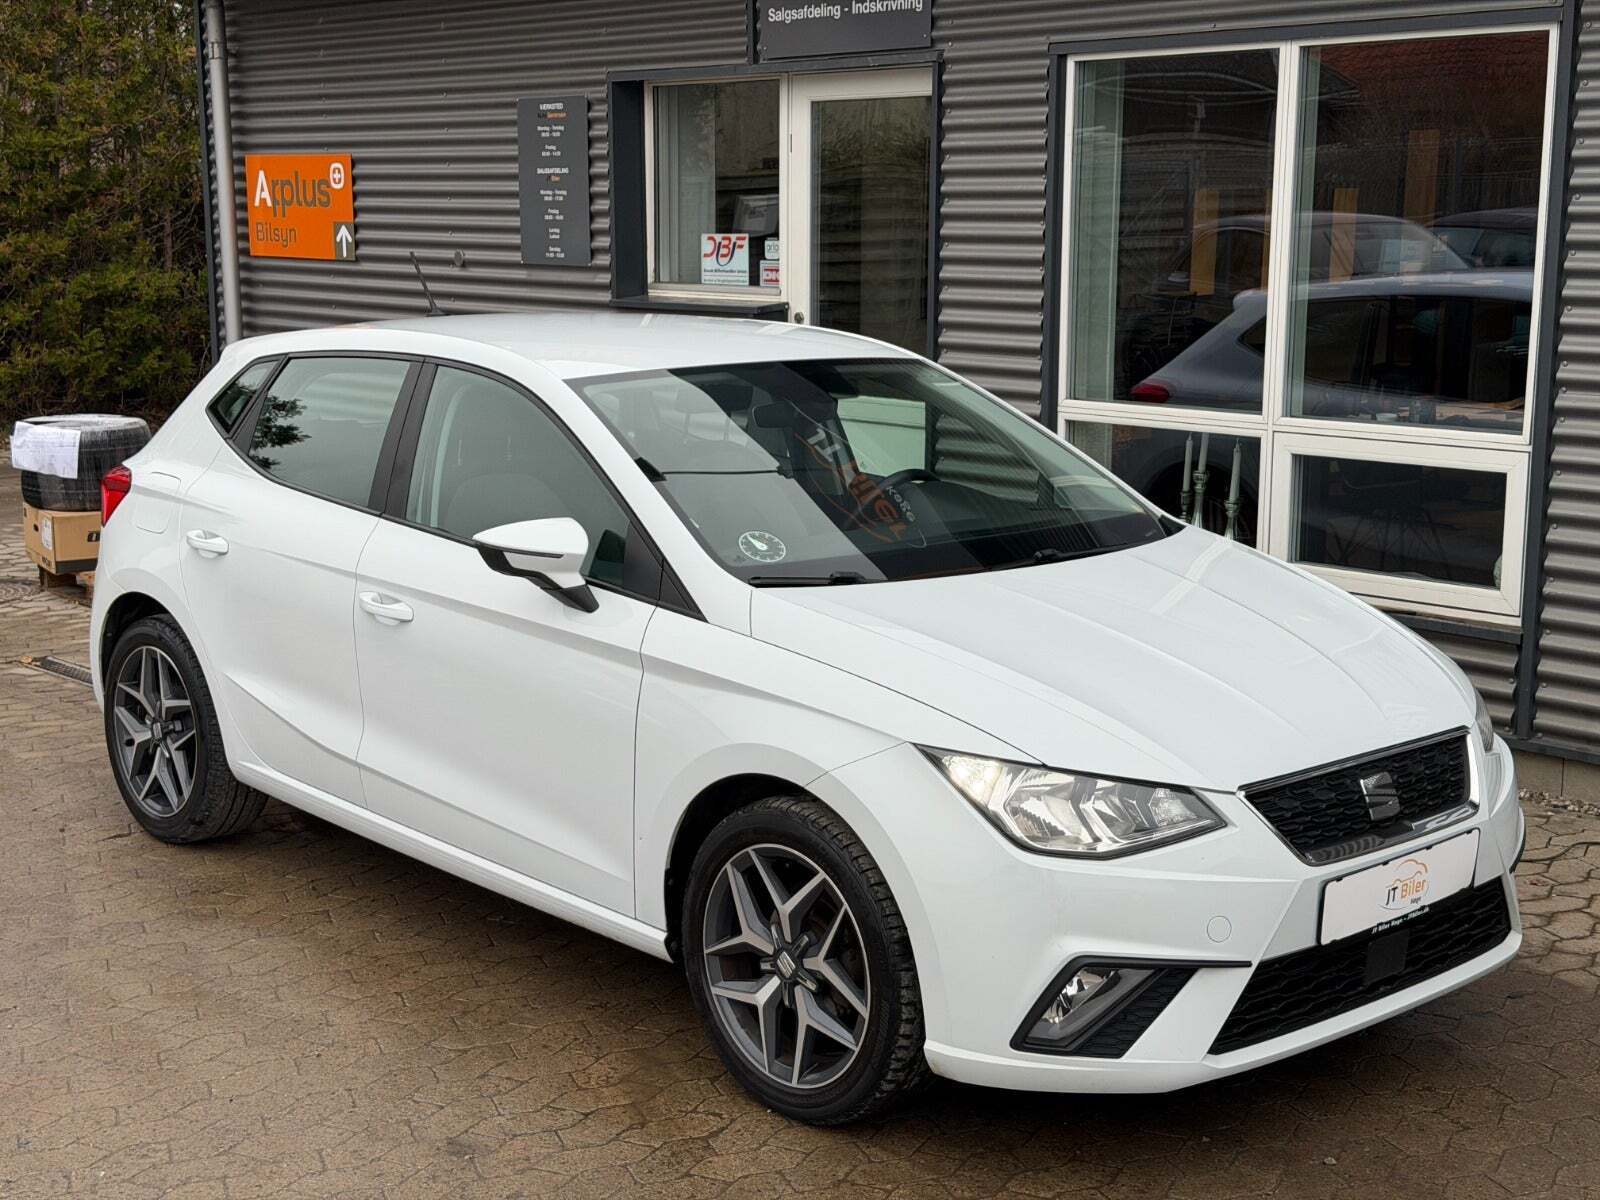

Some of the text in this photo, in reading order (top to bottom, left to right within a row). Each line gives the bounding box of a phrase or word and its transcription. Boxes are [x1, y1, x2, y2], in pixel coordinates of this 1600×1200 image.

[768, 4, 841, 23] Salgsafdeling
[852, 0, 923, 14] Indskrivning
[255, 221, 297, 248] Bilsyn
[1385, 880, 1426, 906] JT Biler
